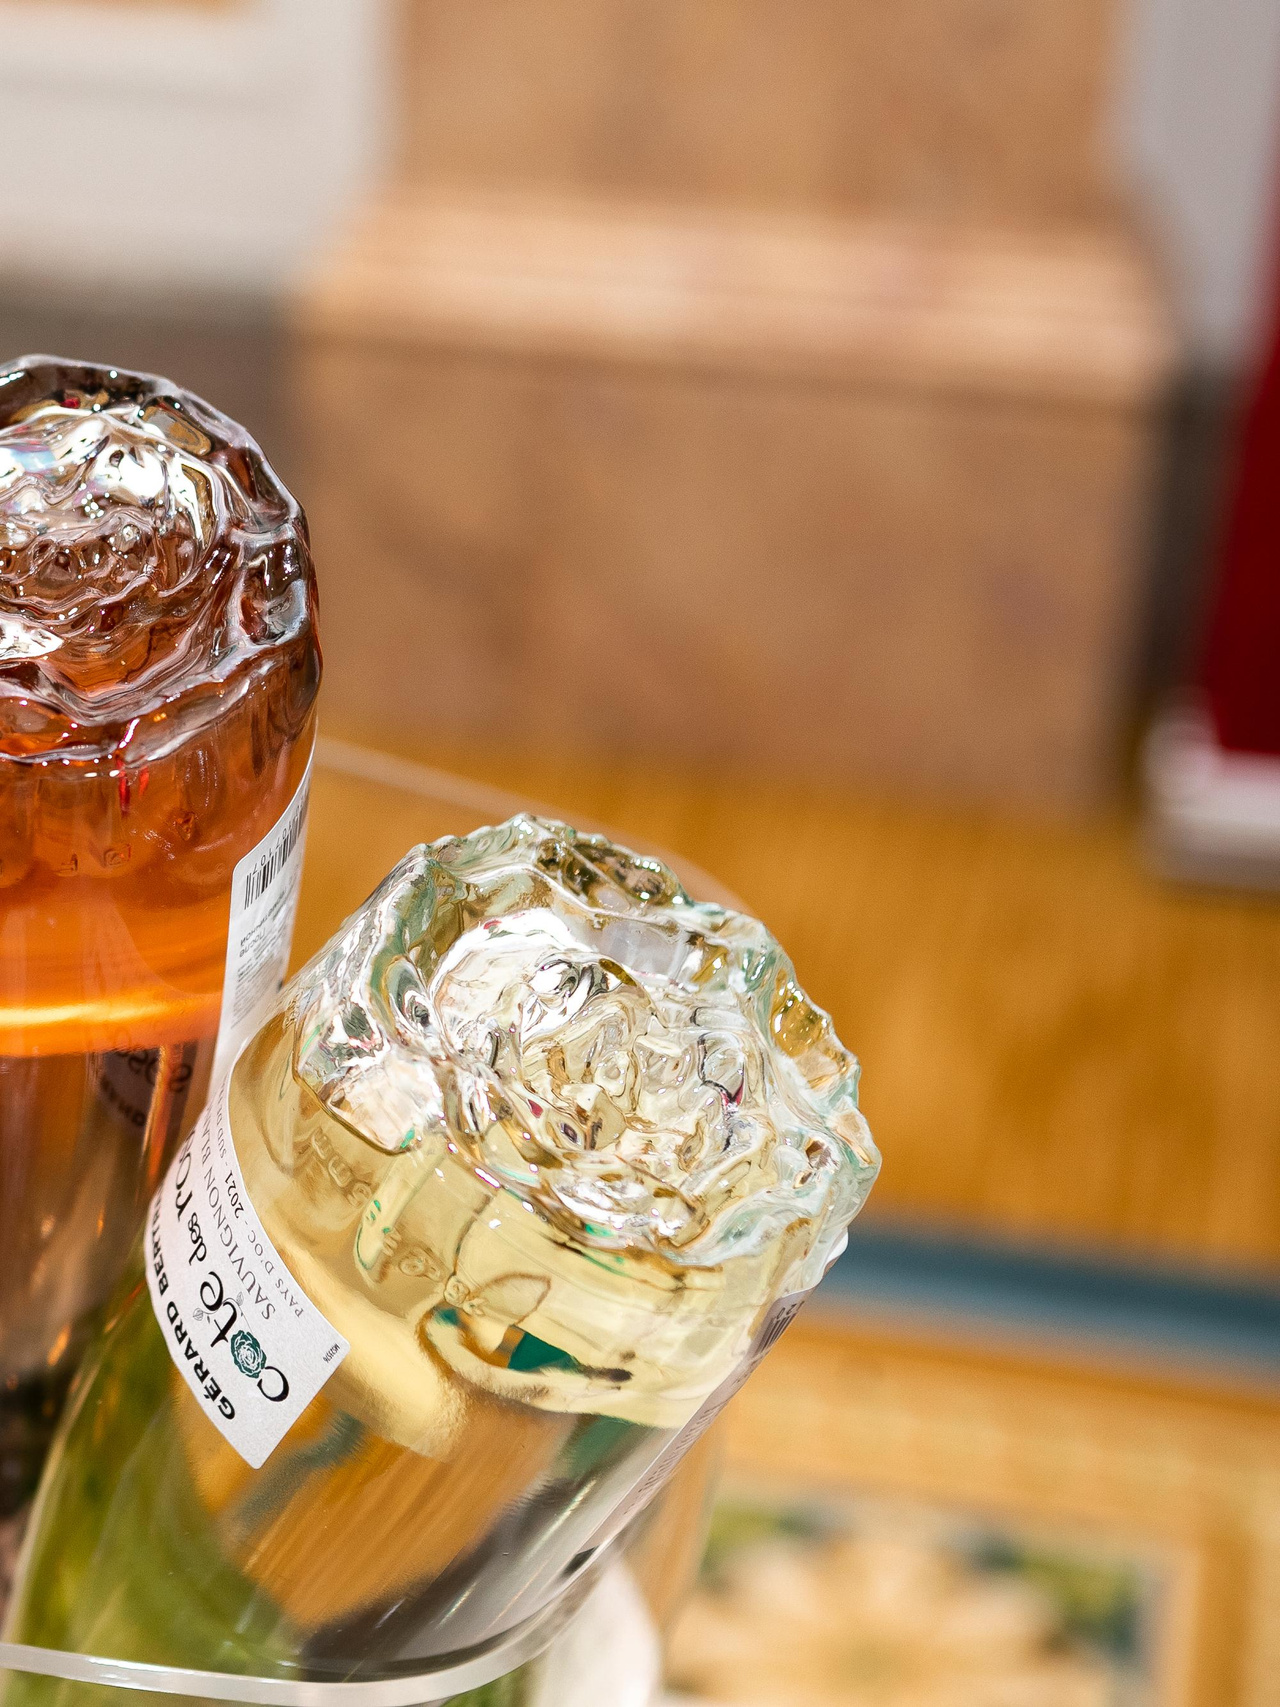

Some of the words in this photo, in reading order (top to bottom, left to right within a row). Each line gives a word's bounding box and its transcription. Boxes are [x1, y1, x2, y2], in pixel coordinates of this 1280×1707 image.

[224, 1171, 246, 1219] 2021
[187, 1212, 208, 1266] des
[203, 1166, 276, 1320] SAUVIGNON
[274, 1278, 304, 1319] PAYS
[166, 1300, 236, 1421] GÉRARD
